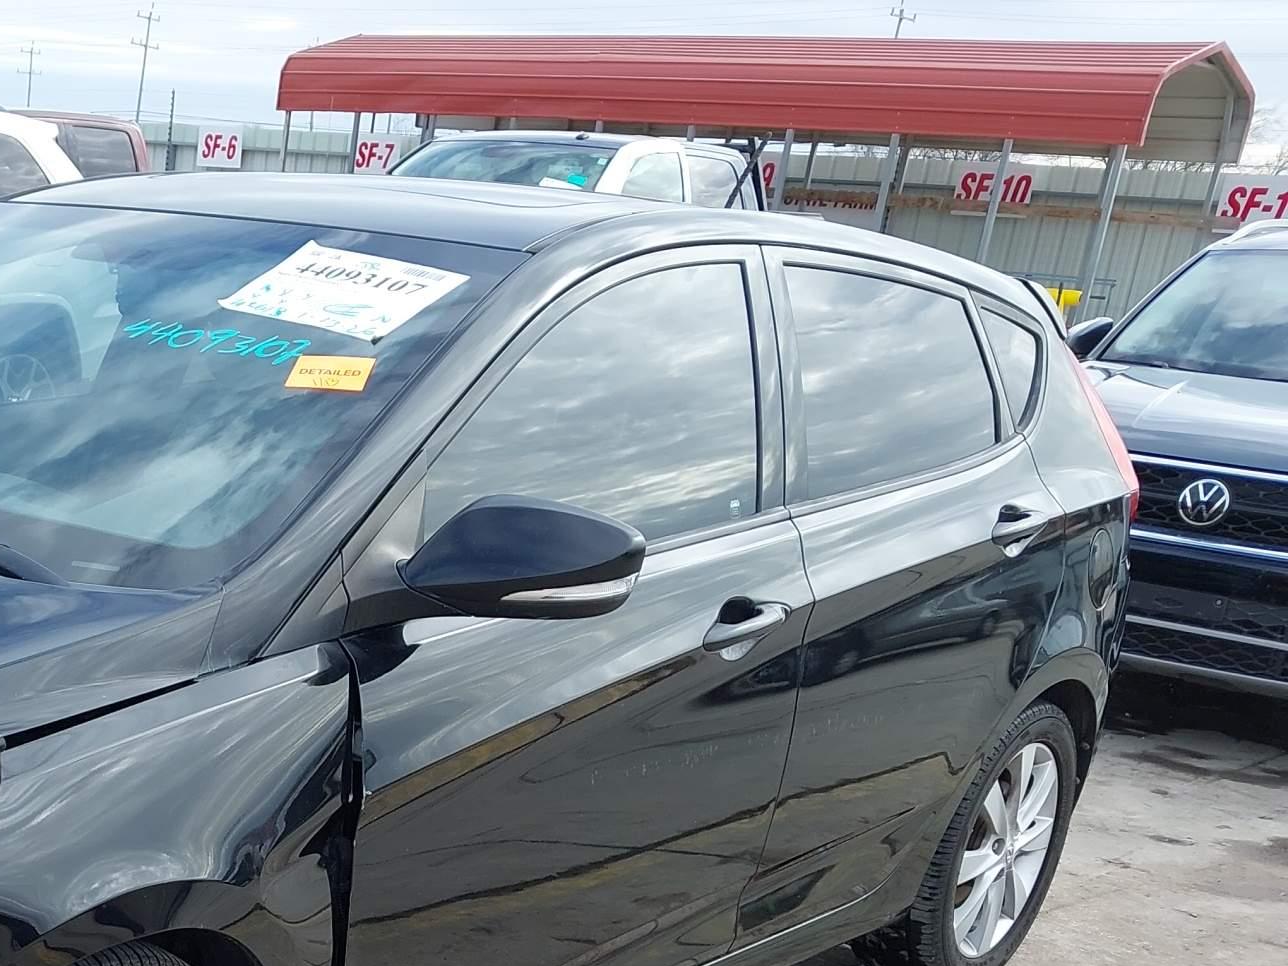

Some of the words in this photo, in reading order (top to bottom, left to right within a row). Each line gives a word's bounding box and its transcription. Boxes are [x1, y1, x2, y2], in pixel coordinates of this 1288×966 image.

[202, 134, 237, 160] SF-6
[355, 142, 395, 169] SF-7
[956, 172, 1032, 203] SF10
[296, 262, 429, 296] 44093107
[298, 367, 362, 378] DETAILED
